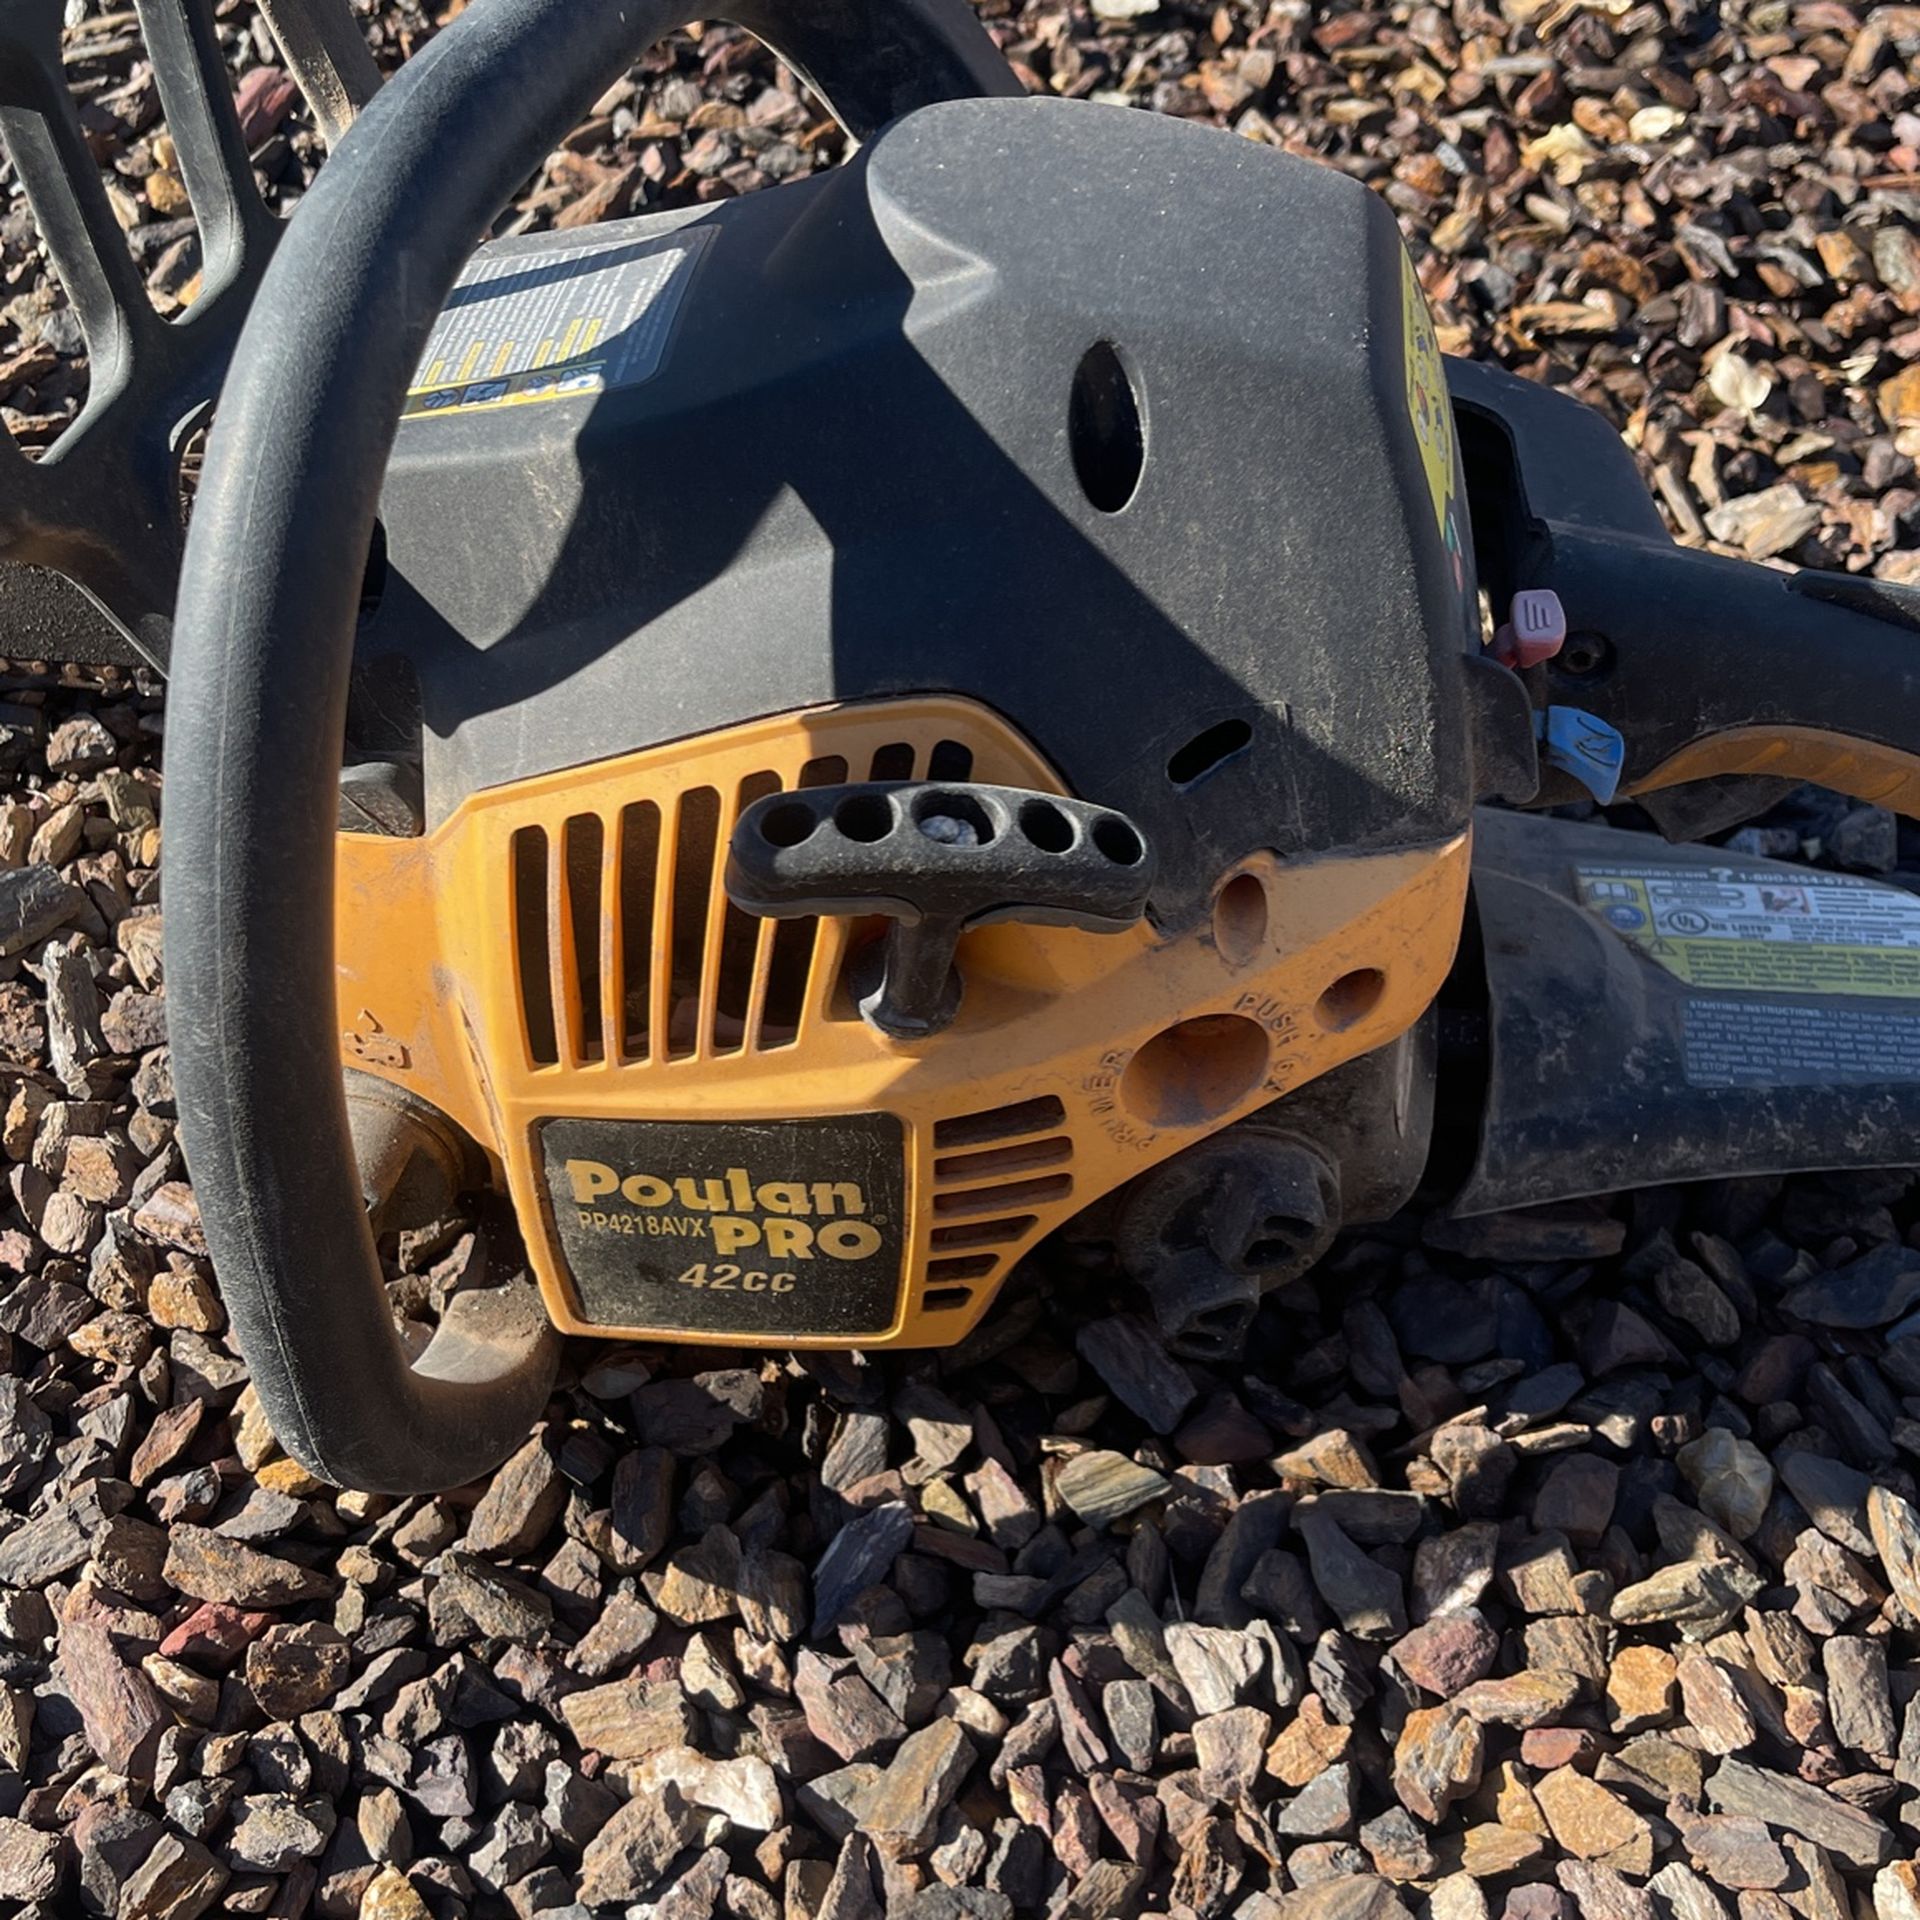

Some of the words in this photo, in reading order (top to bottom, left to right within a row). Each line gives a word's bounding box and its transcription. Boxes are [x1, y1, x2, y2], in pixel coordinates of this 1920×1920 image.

[1233, 992, 1299, 1048] PUSH
[1082, 1048, 1157, 1153] PRIMER
[565, 1159, 866, 1216] Poulan
[578, 1211, 707, 1238] PP4218AVX
[709, 1216, 882, 1261] PRO
[678, 1263, 797, 1293] 42cc
